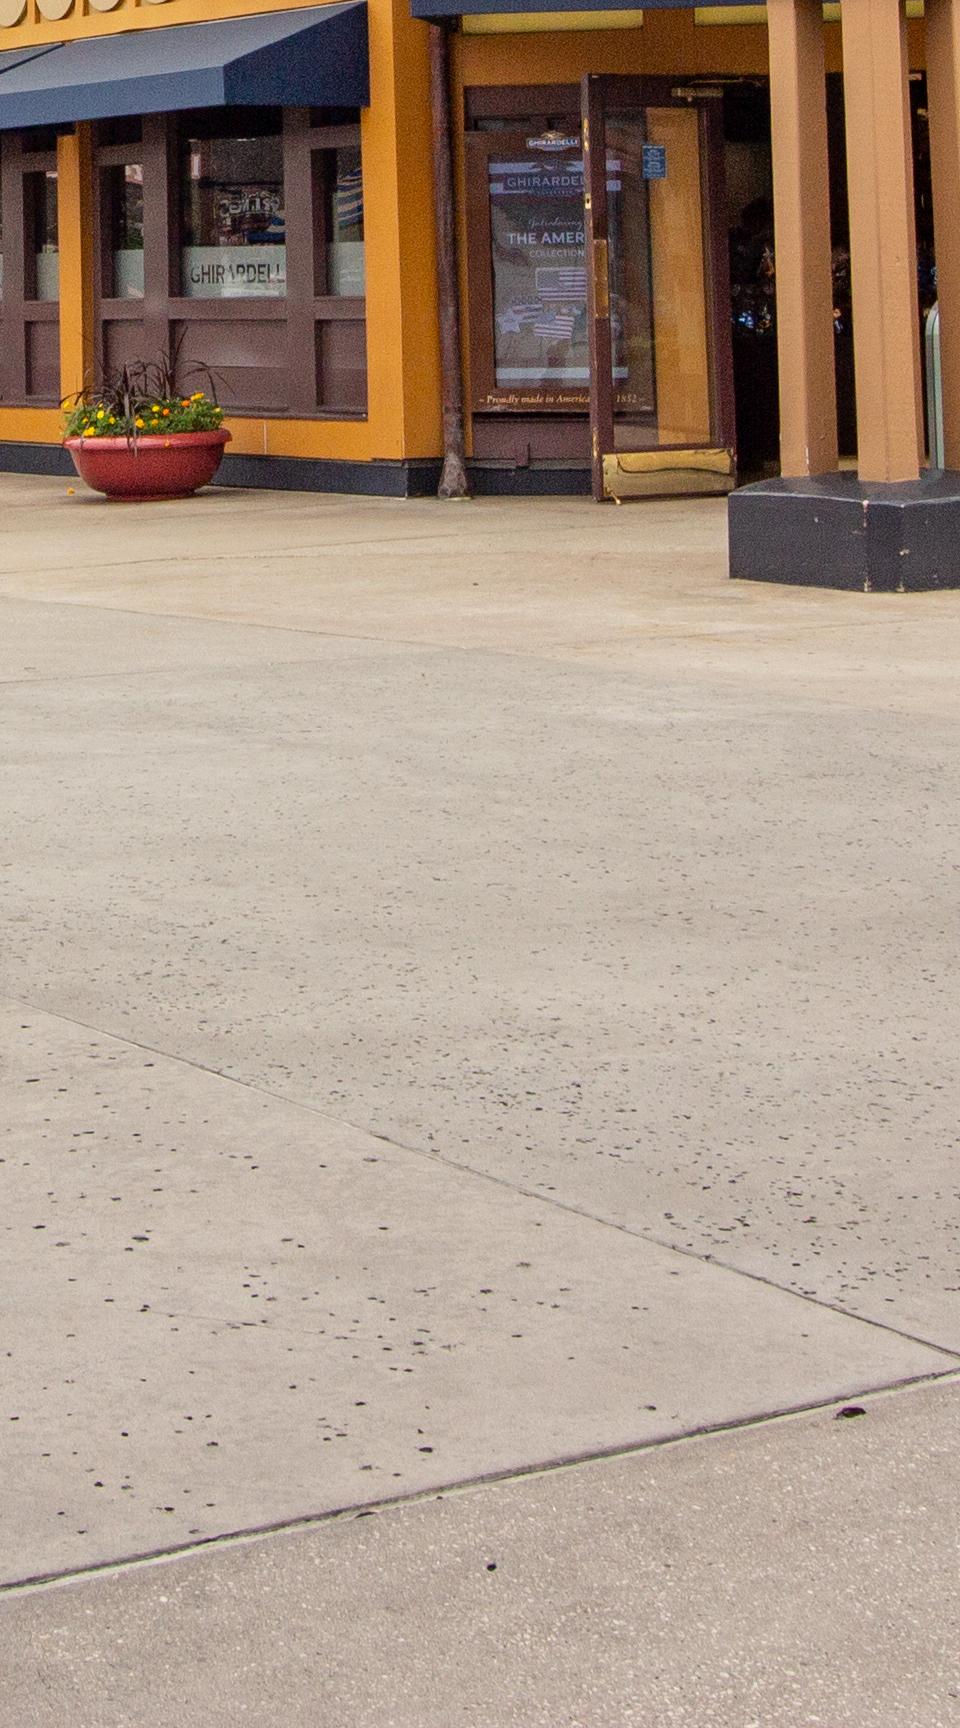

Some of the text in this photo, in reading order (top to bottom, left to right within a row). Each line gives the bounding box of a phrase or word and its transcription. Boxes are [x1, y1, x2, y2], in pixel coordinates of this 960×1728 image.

[507, 231, 585, 245] THE AMER
[486, 393, 638, 405] Proudly made in America 1852
